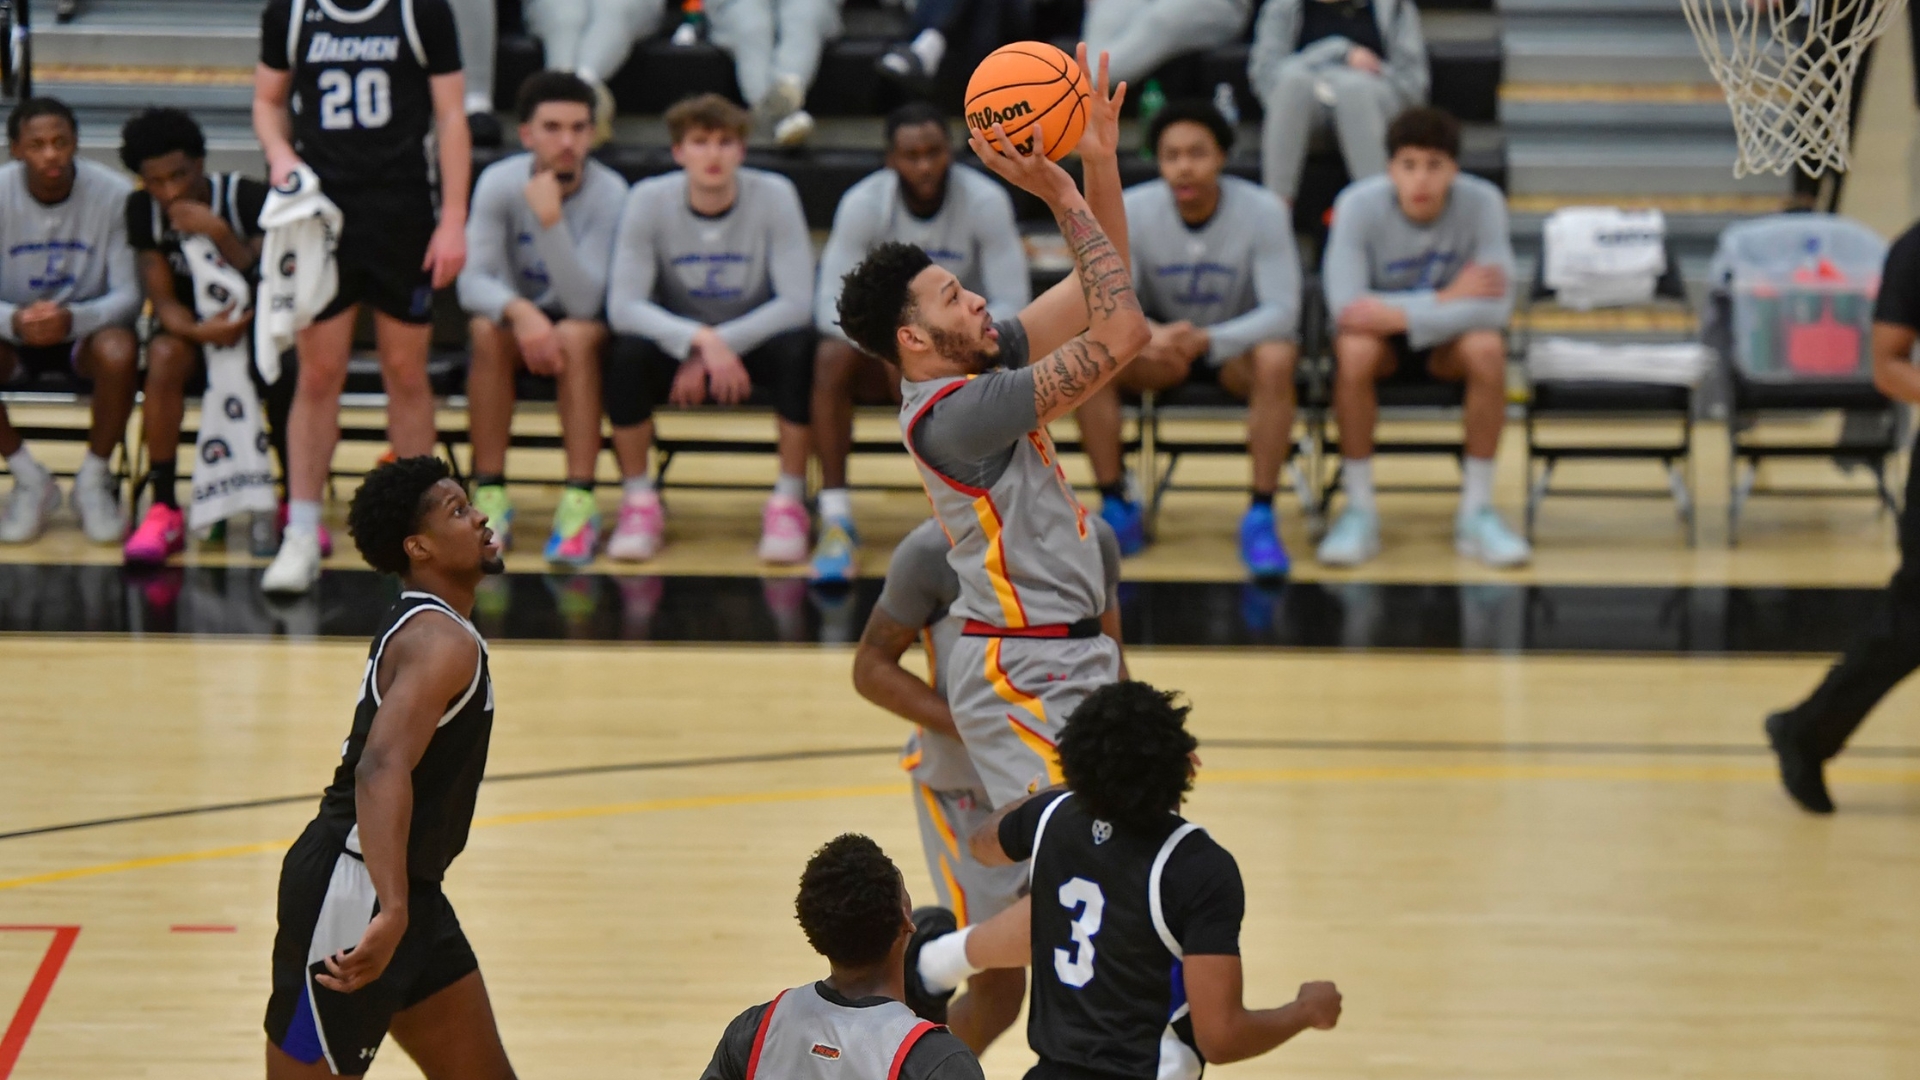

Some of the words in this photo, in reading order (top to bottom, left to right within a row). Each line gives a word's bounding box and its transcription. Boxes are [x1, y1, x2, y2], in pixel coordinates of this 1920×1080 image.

[306, 31, 399, 62] DAEMEN
[318, 68, 392, 130] 20
[967, 100, 1033, 131] Wilson
[1053, 876, 1105, 988] 3
